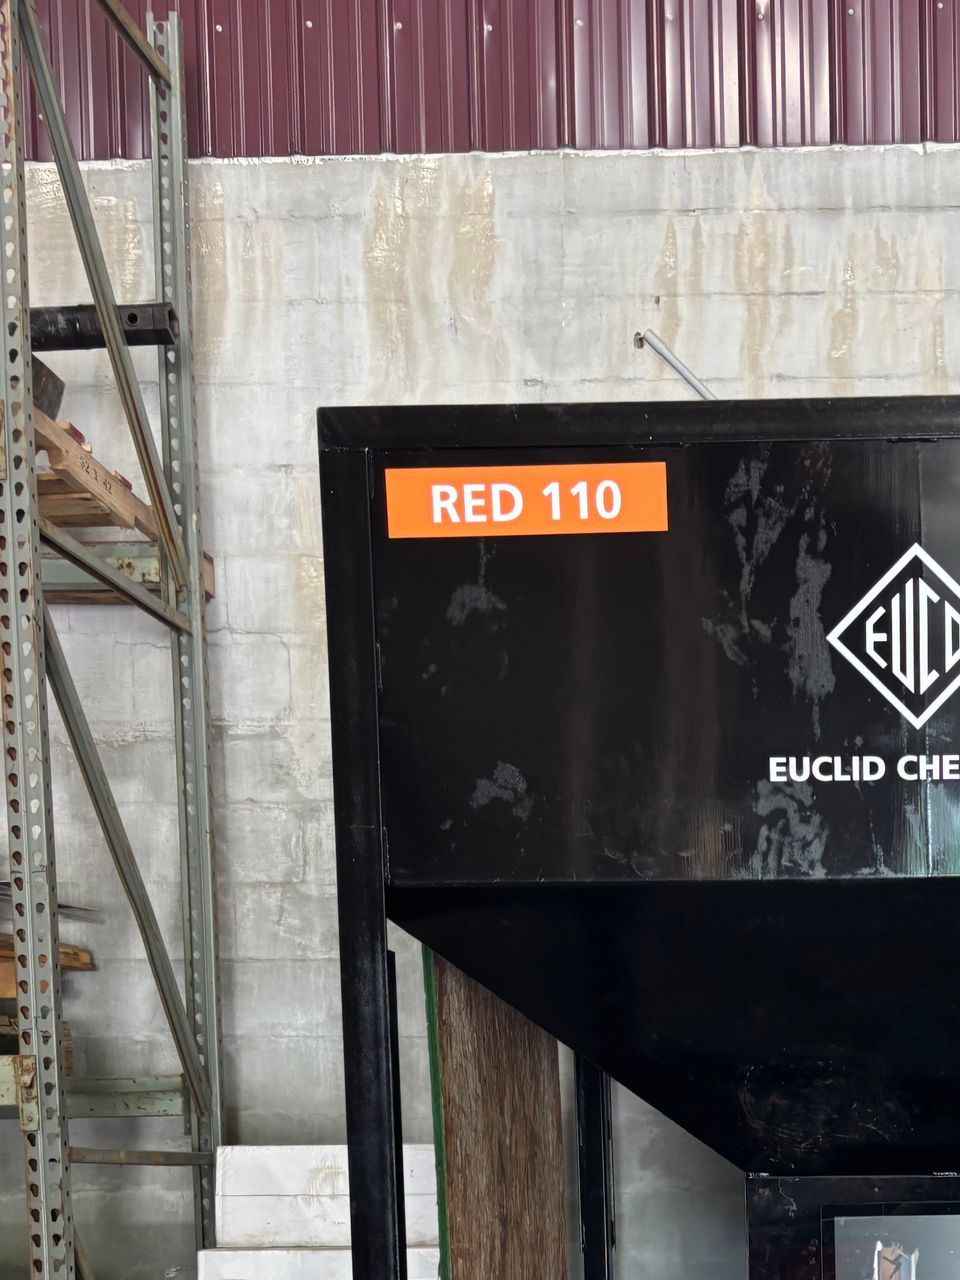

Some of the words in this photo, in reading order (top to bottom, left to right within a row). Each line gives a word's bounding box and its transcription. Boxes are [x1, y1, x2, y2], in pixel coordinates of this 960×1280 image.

[432, 483, 523, 524] RED
[542, 480, 622, 520] 110
[770, 756, 886, 782] EUCLID
